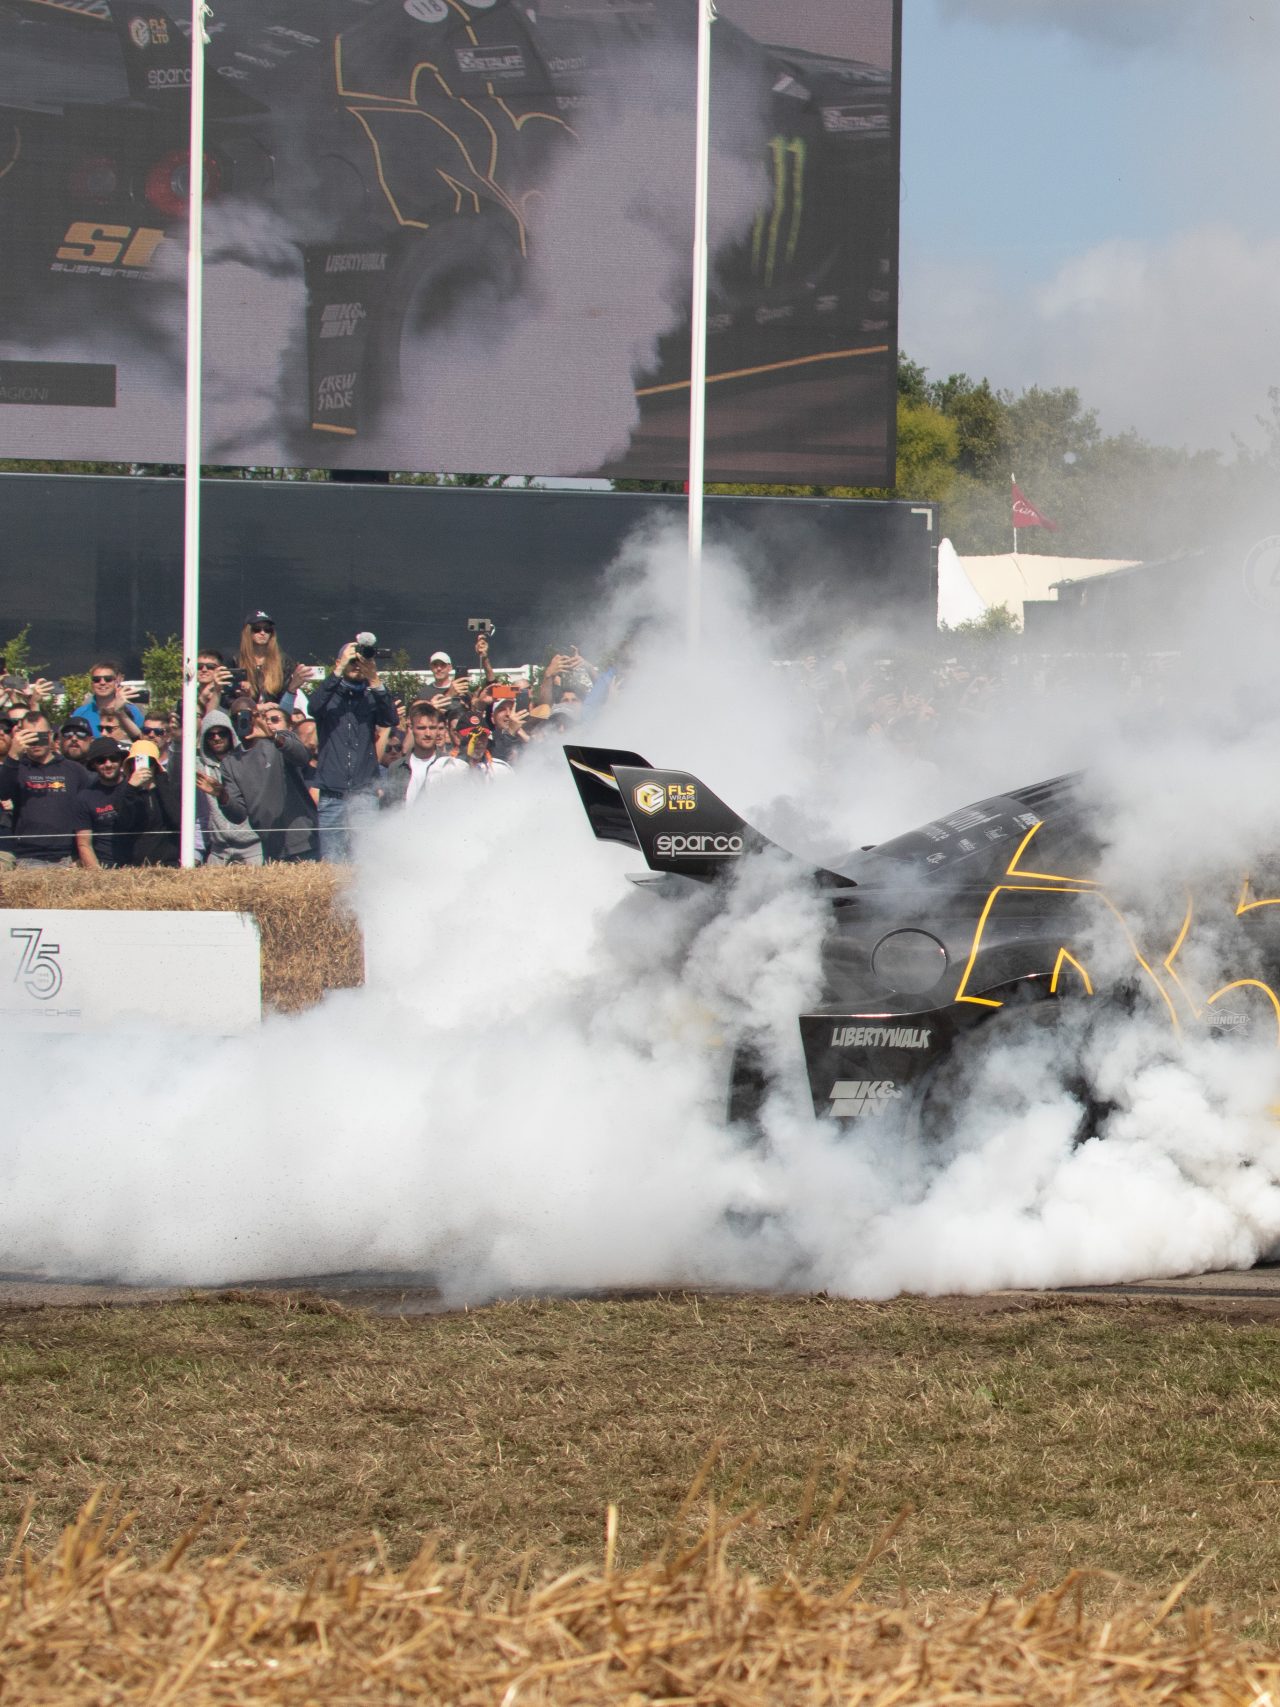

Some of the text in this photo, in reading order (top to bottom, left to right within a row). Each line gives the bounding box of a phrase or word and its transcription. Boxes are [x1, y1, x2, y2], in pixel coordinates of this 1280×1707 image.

[148, 66, 192, 89] sparc
[668, 785, 696, 796] FLS
[668, 800, 696, 810] LTD
[656, 835, 744, 858] sparco
[10, 927, 63, 1001] 75
[1206, 1015, 1247, 1025] SUNOCO
[831, 1027, 932, 1049] LIBERTYWALK
